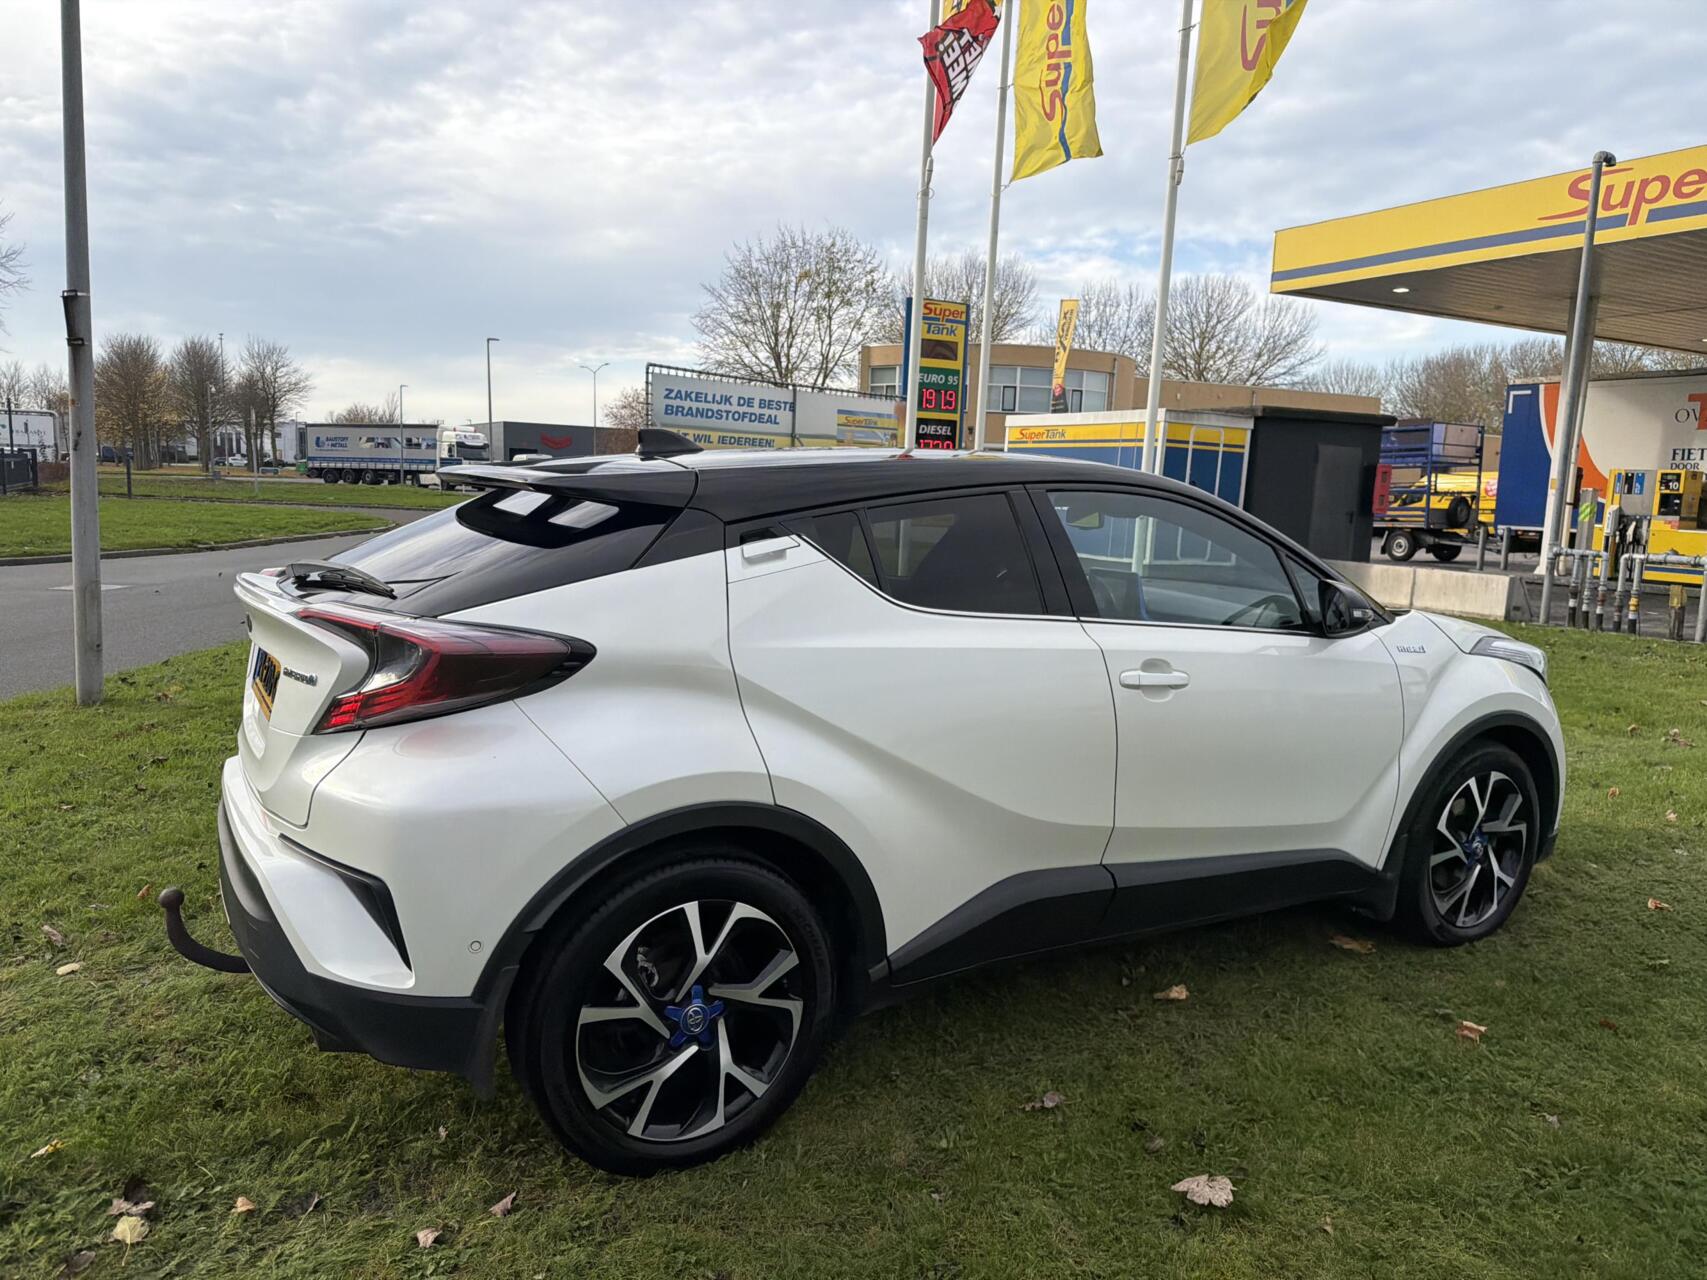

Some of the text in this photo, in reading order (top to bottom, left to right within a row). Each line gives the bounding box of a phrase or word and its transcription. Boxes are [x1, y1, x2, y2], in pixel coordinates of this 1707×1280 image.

[922, 302, 965, 323] Super
[923, 321, 957, 337] Tank
[918, 373, 959, 385] EURO 95
[663, 388, 796, 412] ZAKELIJK DE BESTE
[664, 404, 780, 425] BRANDSTOFDEAL
[919, 424, 953, 435] DIESEL
[1015, 428, 1067, 441] SuperTank
[693, 433, 713, 444] WIL
[717, 434, 775, 448] IEDEREEN!
[1670, 462, 1700, 470] DOOR
[1668, 482, 1679, 490] 10
